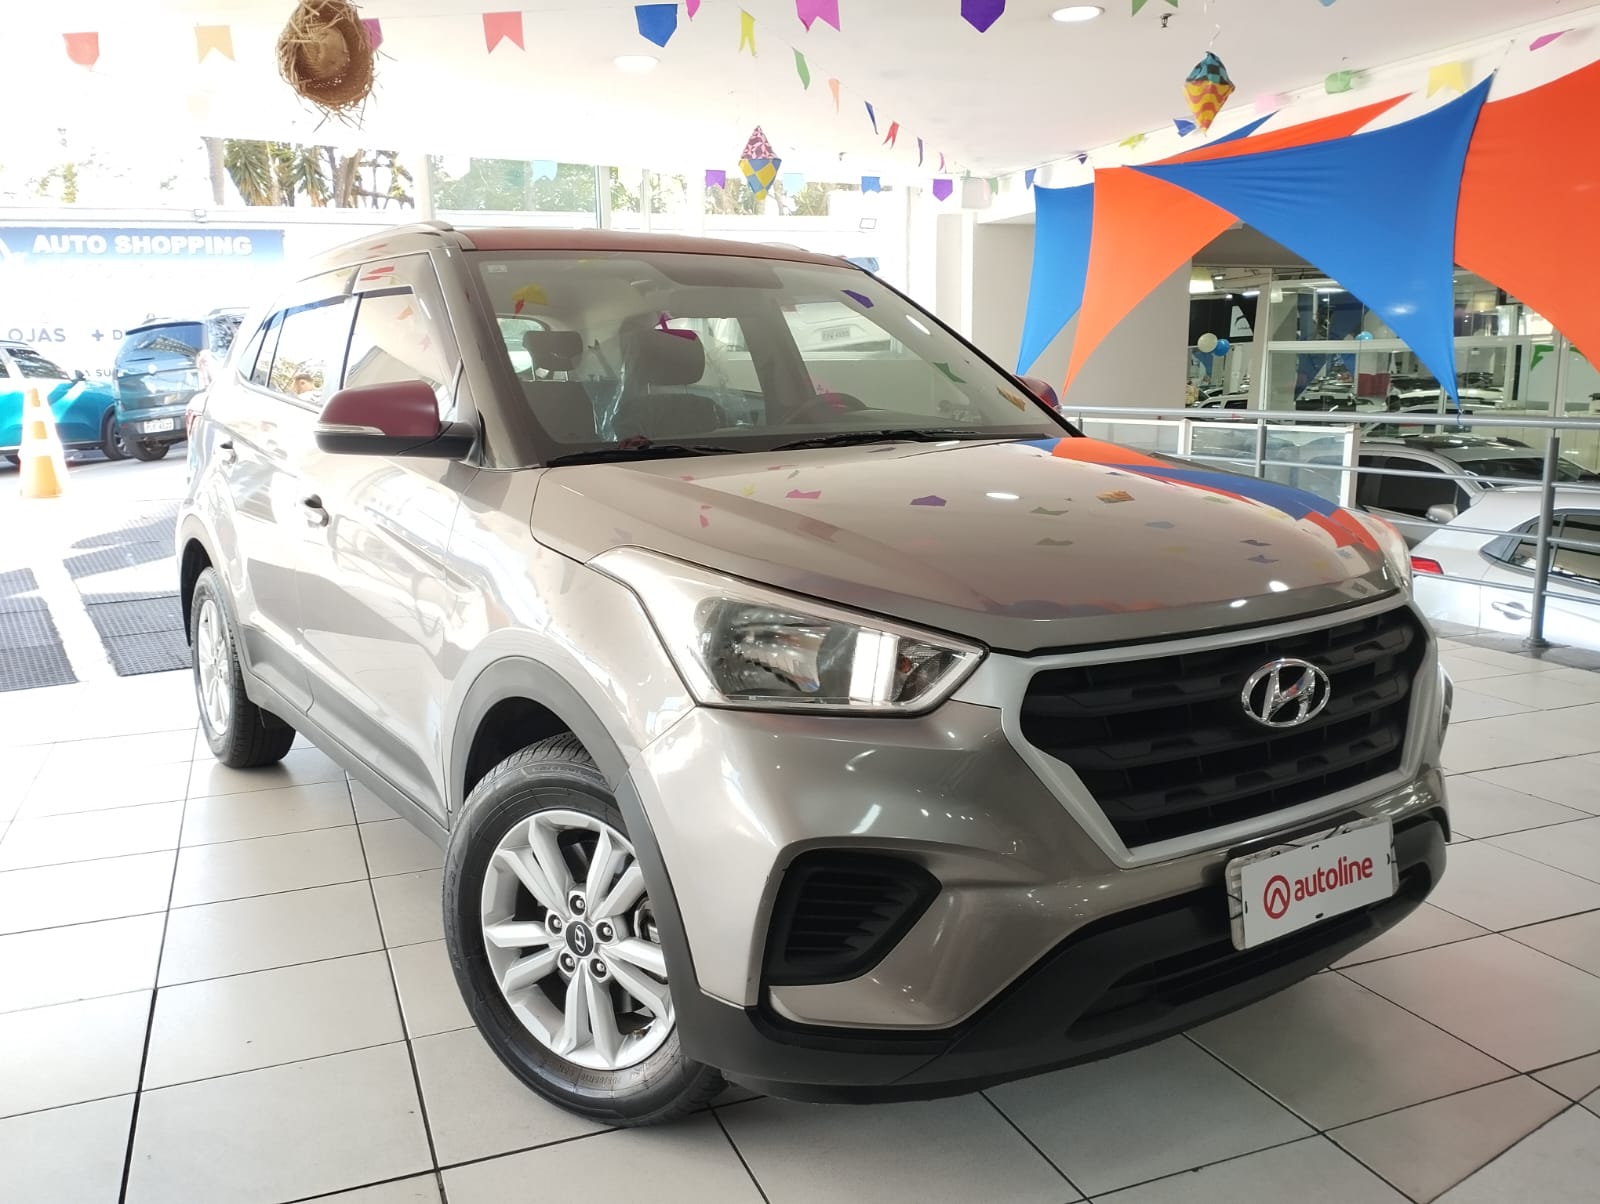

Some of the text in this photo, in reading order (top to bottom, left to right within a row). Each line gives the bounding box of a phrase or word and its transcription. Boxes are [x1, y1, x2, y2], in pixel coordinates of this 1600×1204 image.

[33, 235, 253, 255] AUTO SHOPPING
[8, 328, 66, 342] OJAS
[1294, 856, 1372, 902] autoline
